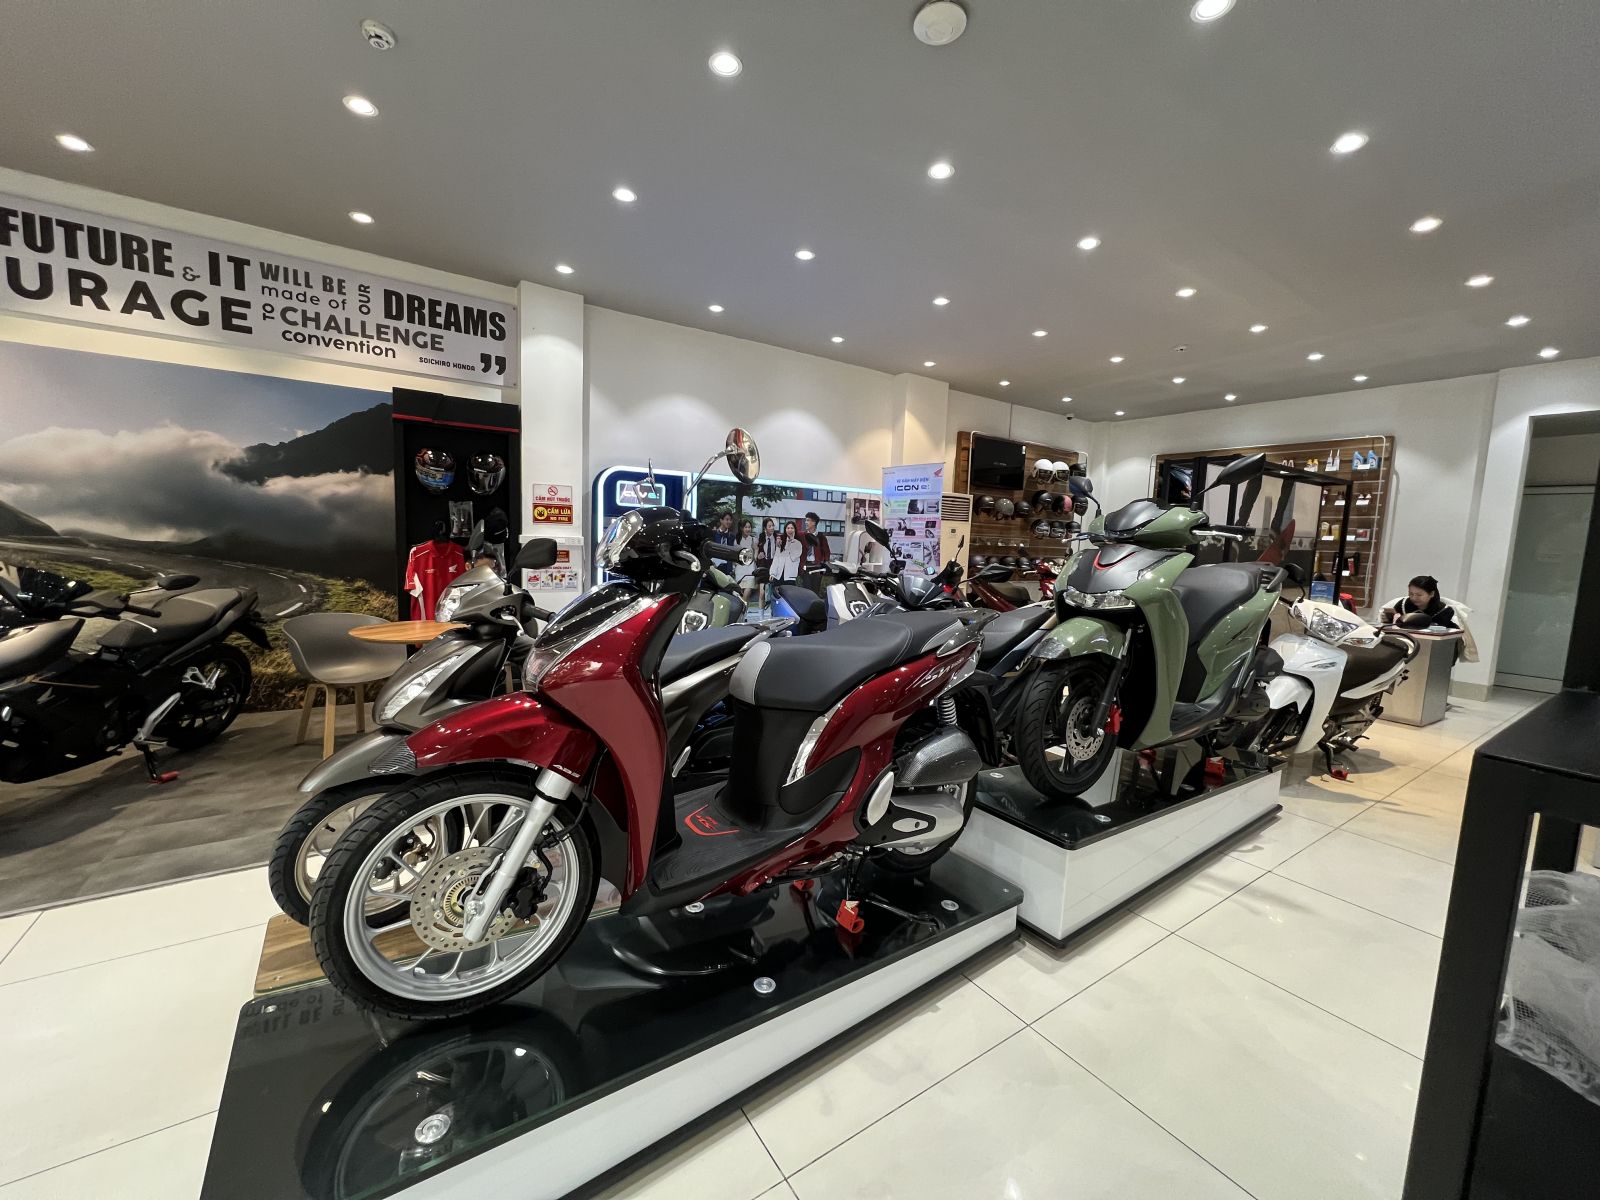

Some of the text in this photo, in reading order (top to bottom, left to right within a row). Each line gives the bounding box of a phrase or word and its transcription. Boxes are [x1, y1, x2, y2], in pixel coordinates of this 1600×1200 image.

[0, 207, 251, 291] FUTURE & IT
[259, 261, 347, 296] WILL BE
[5, 256, 253, 335] URAGE
[262, 285, 347, 311] made of
[262, 303, 275, 321] TO
[358, 283, 371, 316] OUR
[280, 306, 445, 353] CHALLENGE
[383, 288, 507, 342] DREAMS
[281, 330, 396, 359] convention
[419, 356, 451, 368] SOICHIRO
[453, 362, 476, 372] HONDA
[547, 507, 560, 515] CẤM
